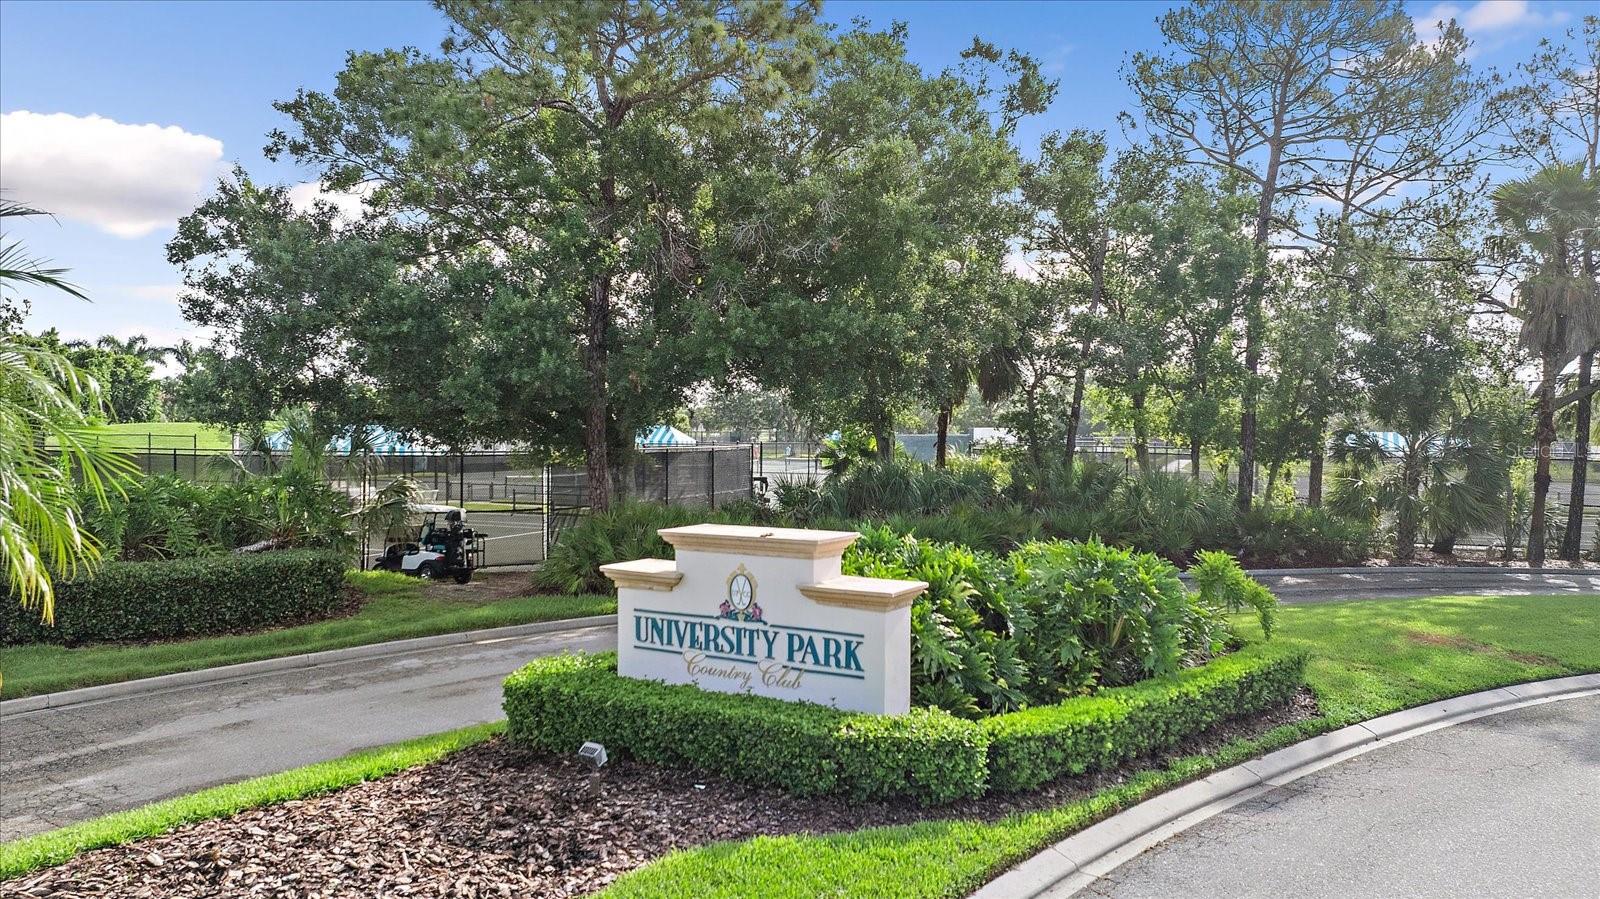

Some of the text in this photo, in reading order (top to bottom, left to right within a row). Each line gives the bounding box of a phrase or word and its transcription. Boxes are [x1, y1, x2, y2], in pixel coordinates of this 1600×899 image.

[634, 615, 865, 672] UNIVERSITY PARK
[683, 650, 805, 689] Country Club
